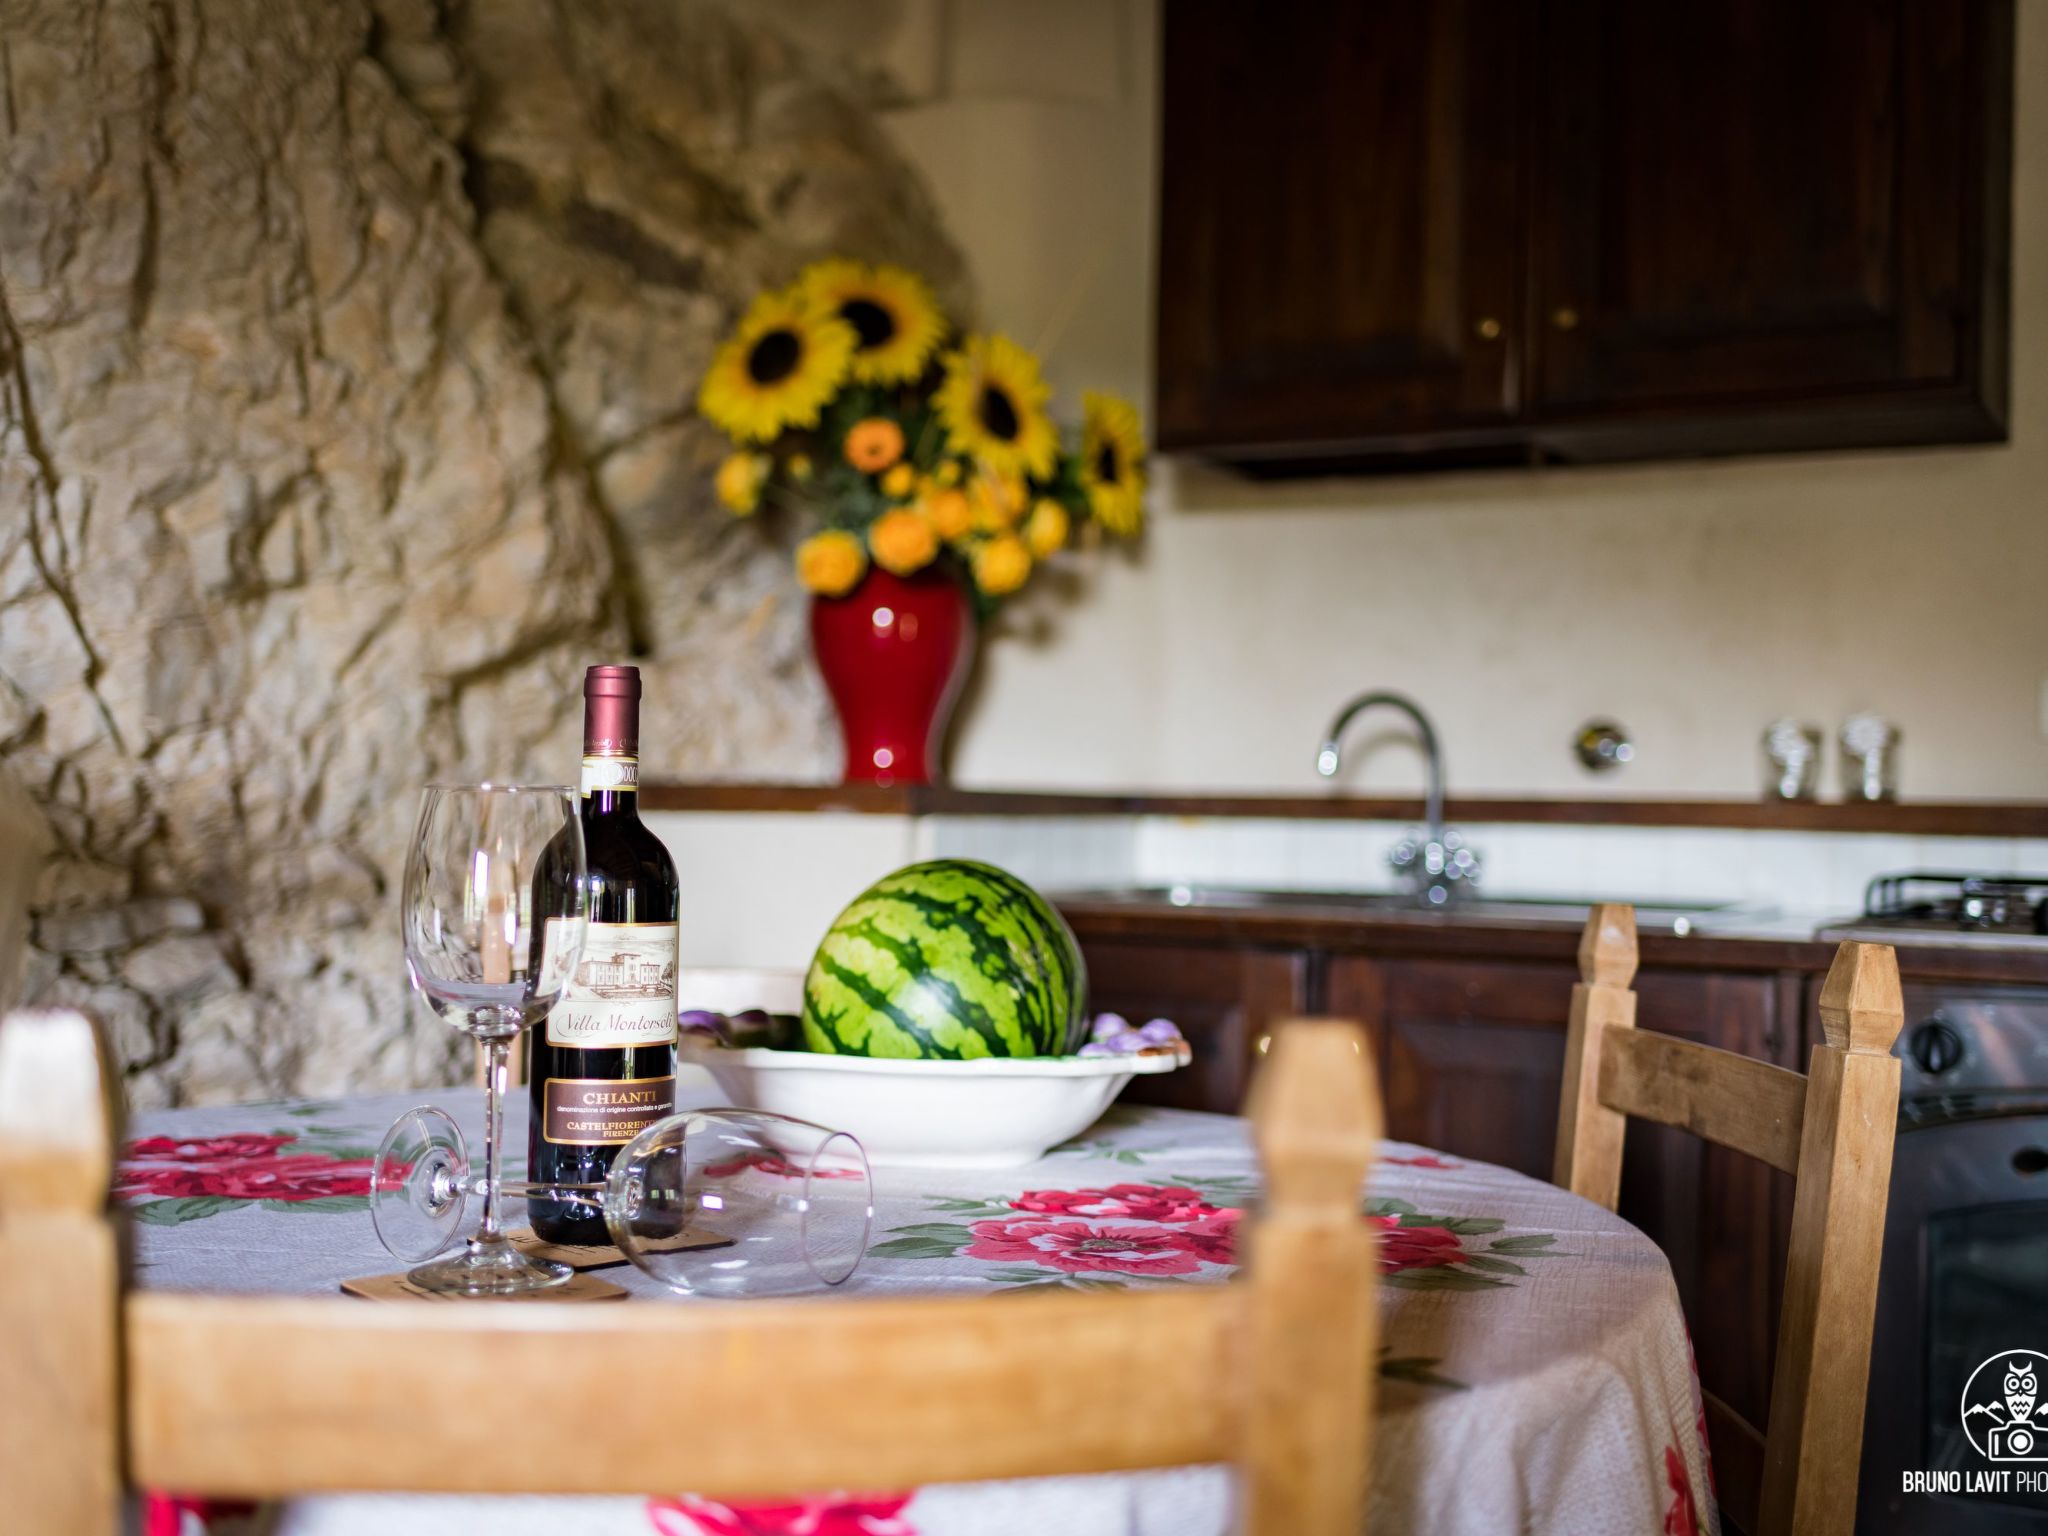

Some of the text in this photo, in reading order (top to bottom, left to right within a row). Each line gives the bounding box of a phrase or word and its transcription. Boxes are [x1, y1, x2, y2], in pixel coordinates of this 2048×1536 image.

[560, 1013, 600, 1033] Villa
[583, 1090, 657, 1105] CHIANTI
[557, 1105, 599, 1114] denominazione
[599, 1106, 606, 1114] di
[606, 1106, 626, 1115] origine
[603, 1129, 639, 1137] FIRENZE
